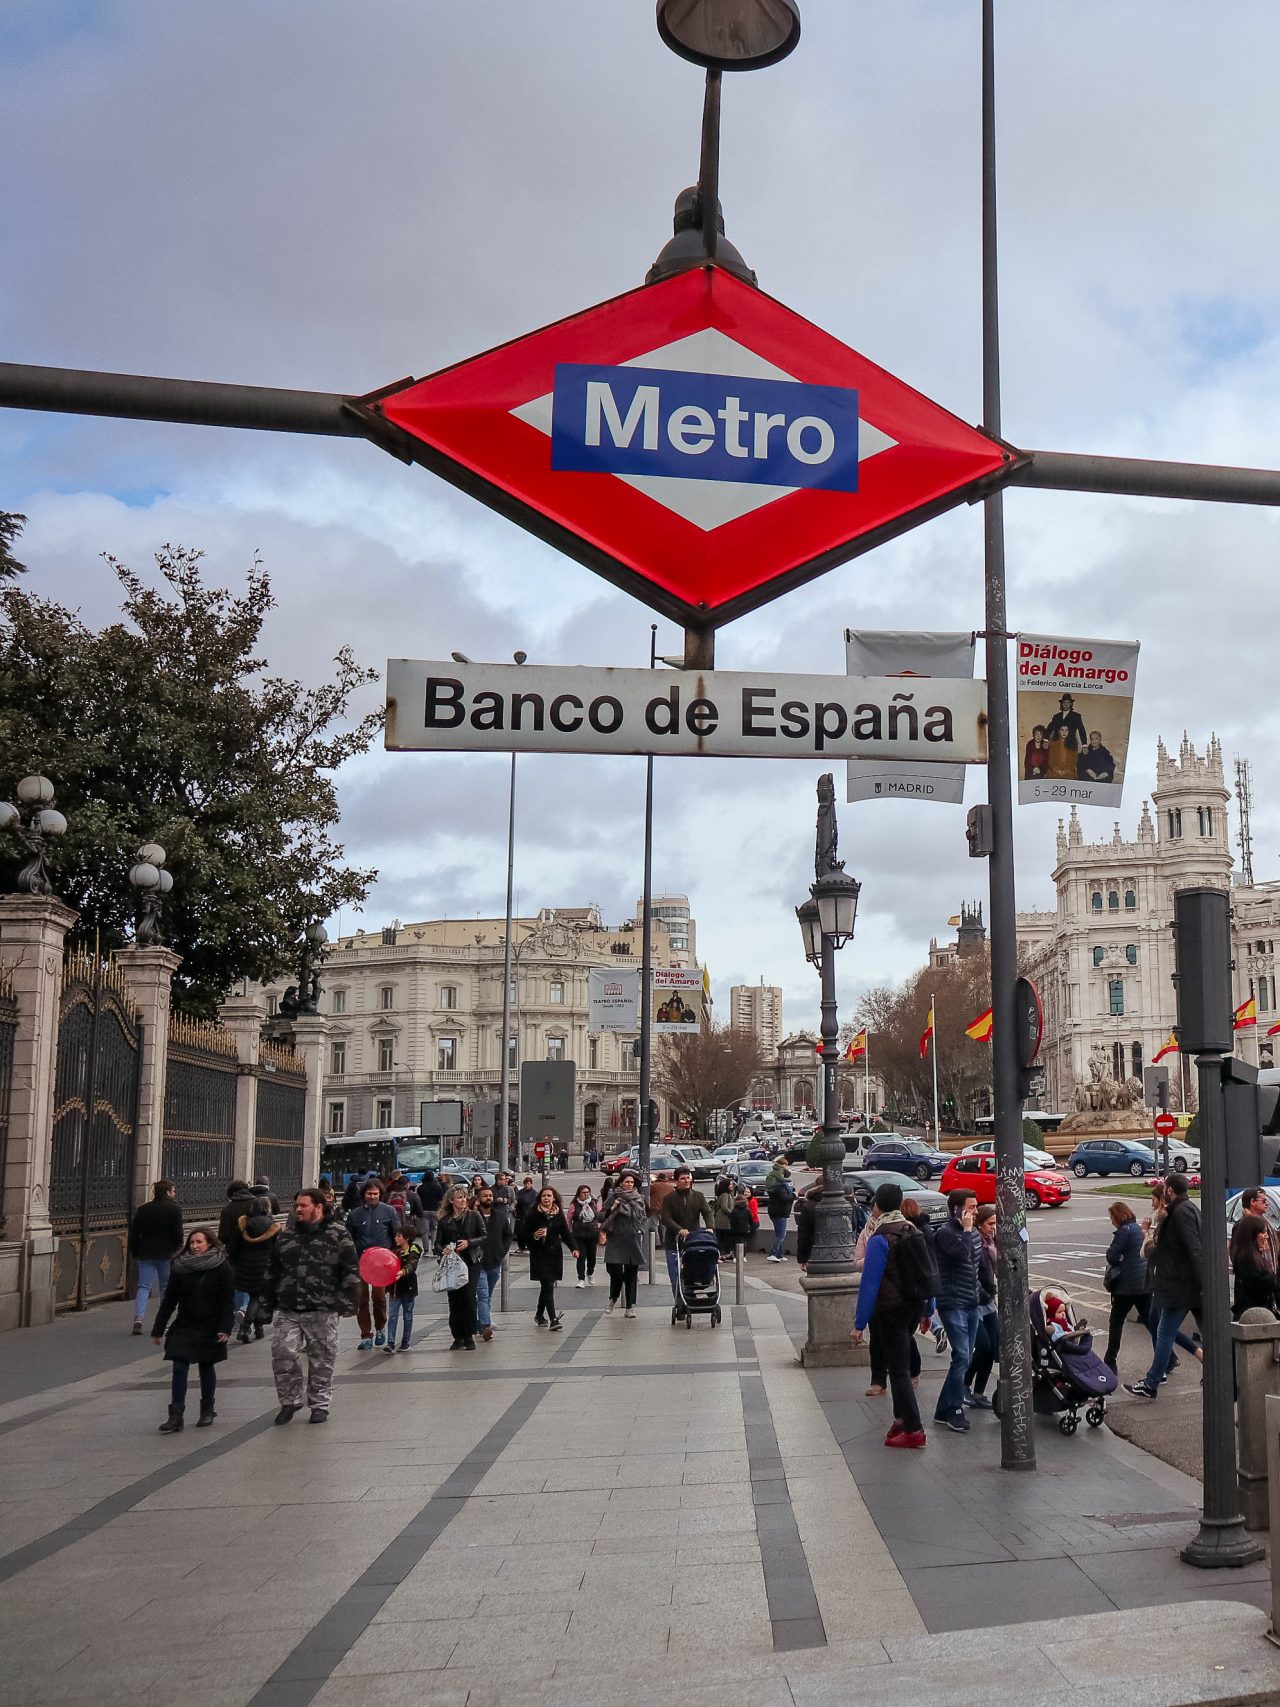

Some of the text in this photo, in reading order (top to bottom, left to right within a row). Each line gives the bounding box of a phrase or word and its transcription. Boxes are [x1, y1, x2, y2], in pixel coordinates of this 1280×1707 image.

[584, 381, 835, 465] Metro
[1019, 642, 1093, 664] Diálogo
[1018, 661, 1129, 684] del Amargo
[1026, 678, 1057, 687] Federico
[1058, 680, 1082, 689] García
[1083, 682, 1104, 690] Lorca
[424, 676, 954, 751] Banco de España
[888, 783, 934, 795] MADRID
[1034, 785, 1041, 797] 5
[1051, 785, 1067, 797] 29
[1070, 787, 1094, 799] mar
[655, 971, 685, 980] Diálogo
